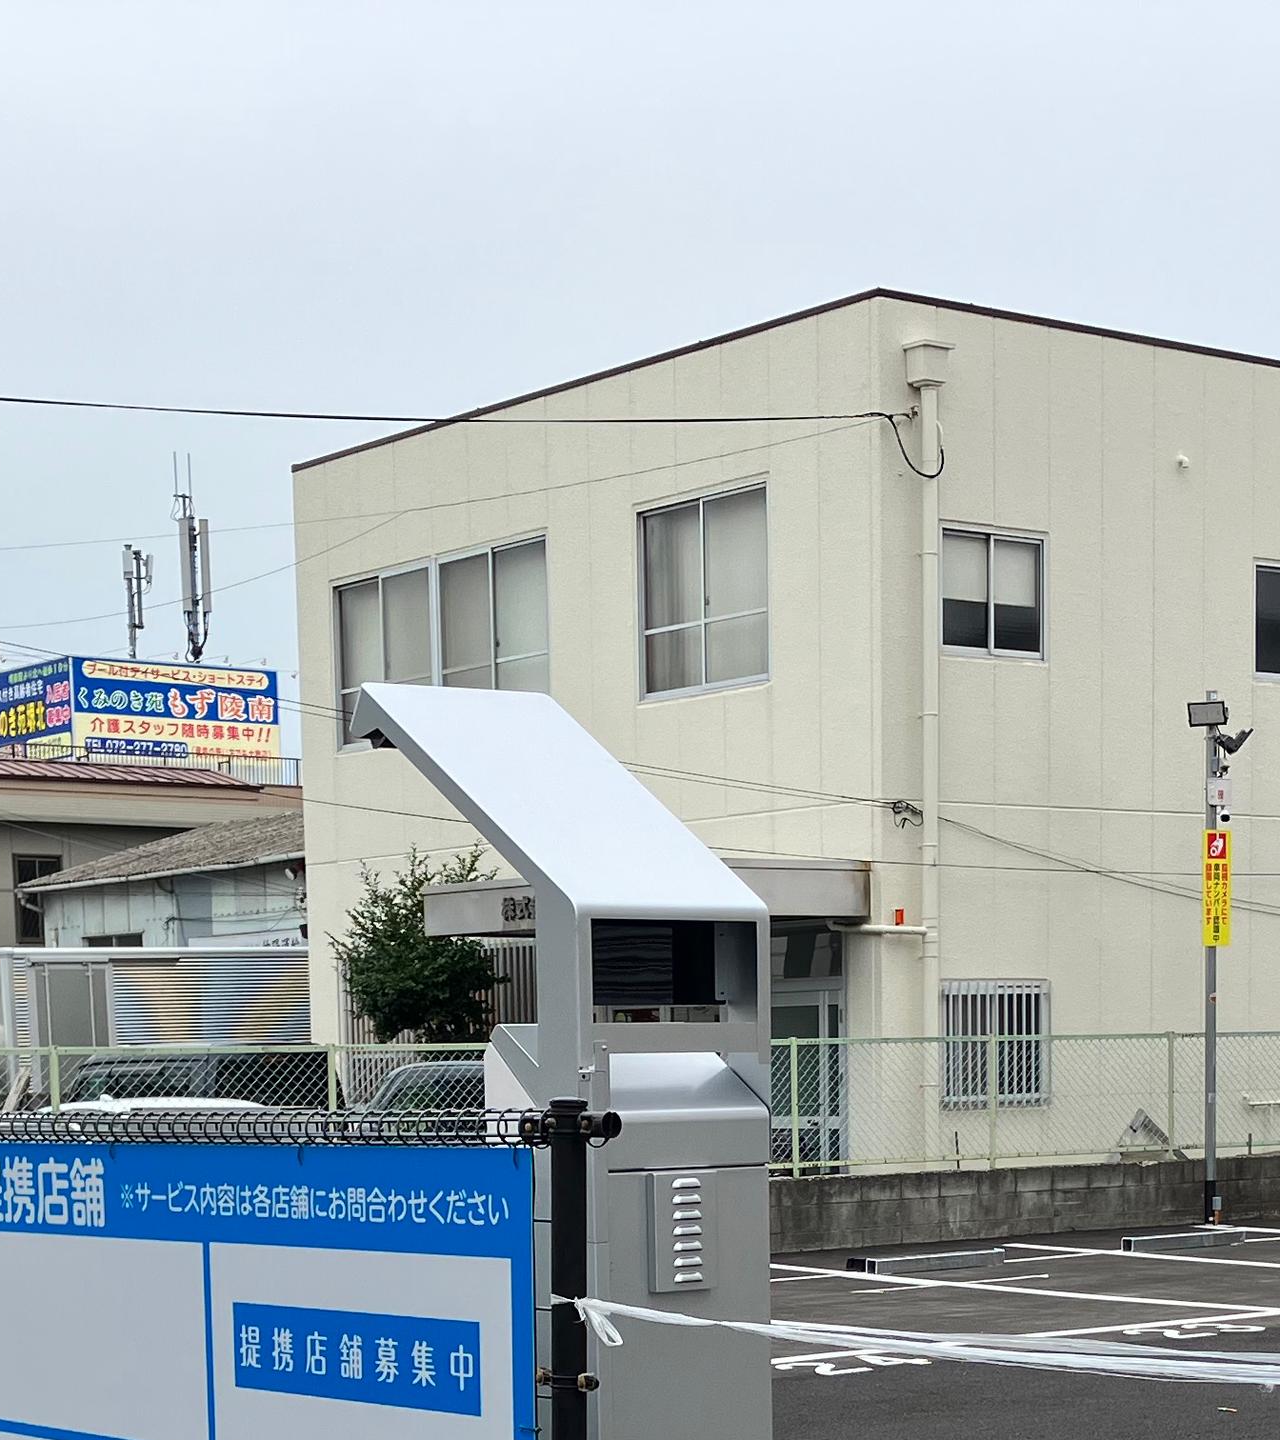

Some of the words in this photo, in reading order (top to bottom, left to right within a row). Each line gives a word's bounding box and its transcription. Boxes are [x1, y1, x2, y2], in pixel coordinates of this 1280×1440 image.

[1122, 1322, 1267, 1340] 23
[240, 1323, 474, 1392] 提携店舗募集中
[774, 1353, 933, 1376] 24
